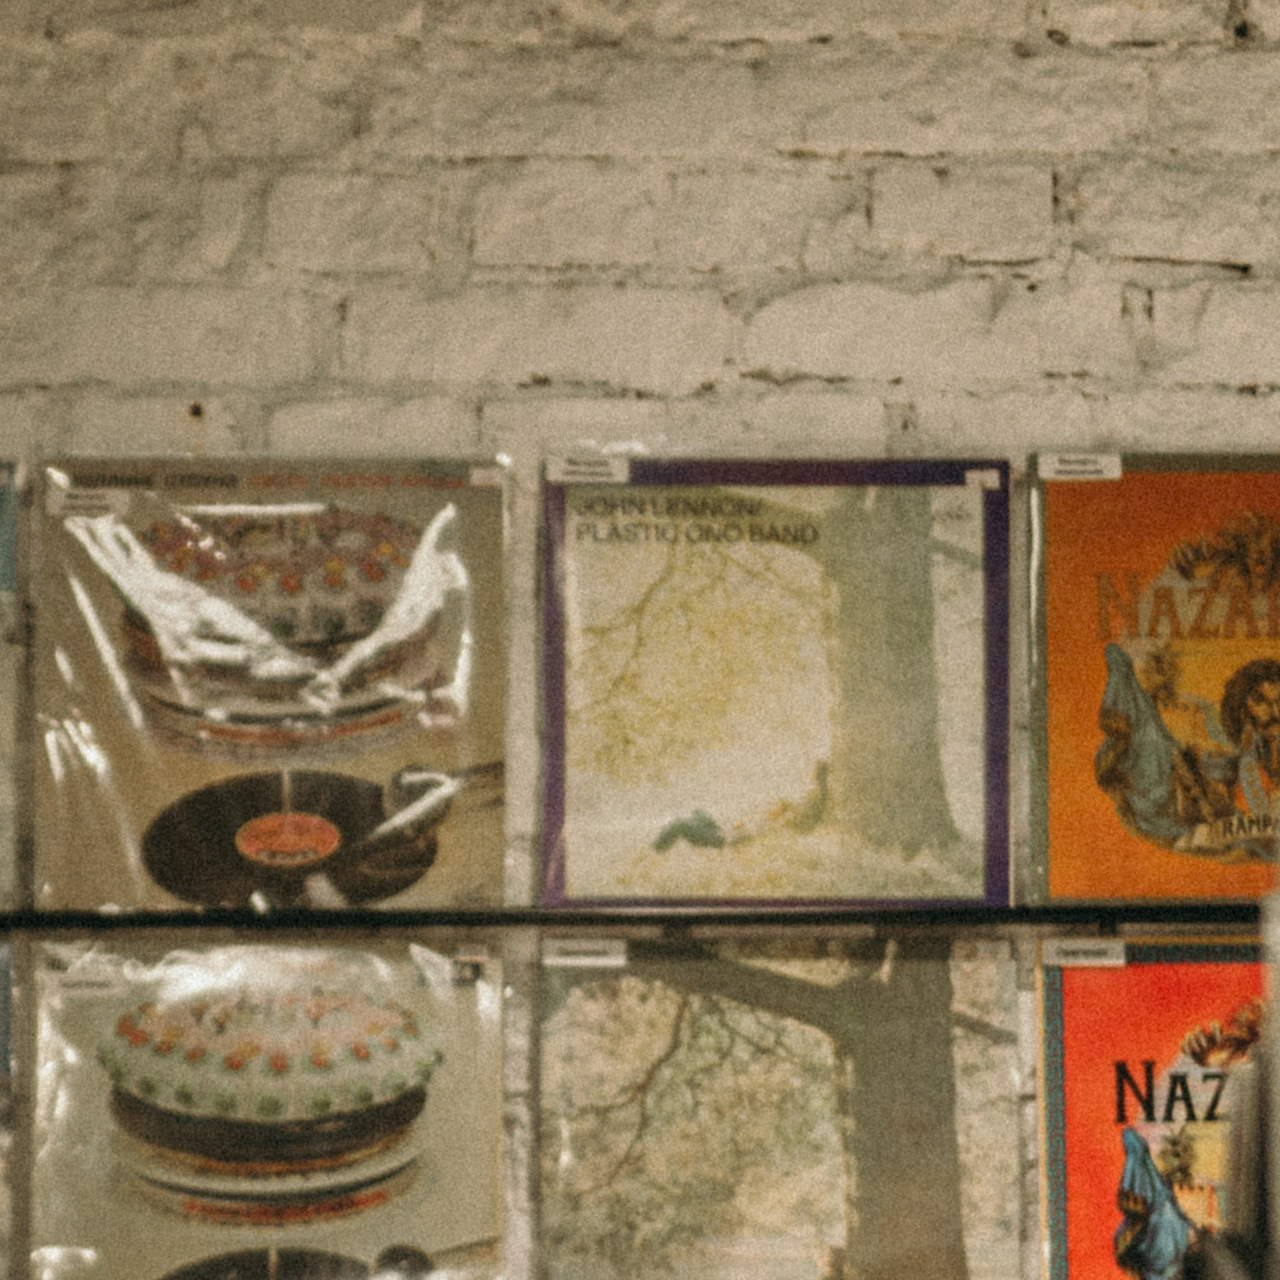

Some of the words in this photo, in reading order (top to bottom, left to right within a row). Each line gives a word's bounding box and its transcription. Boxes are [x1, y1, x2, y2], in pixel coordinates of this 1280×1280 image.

[575, 523, 679, 545] PLASTIC
[686, 523, 742, 544] ONO
[749, 523, 819, 544] BAND
